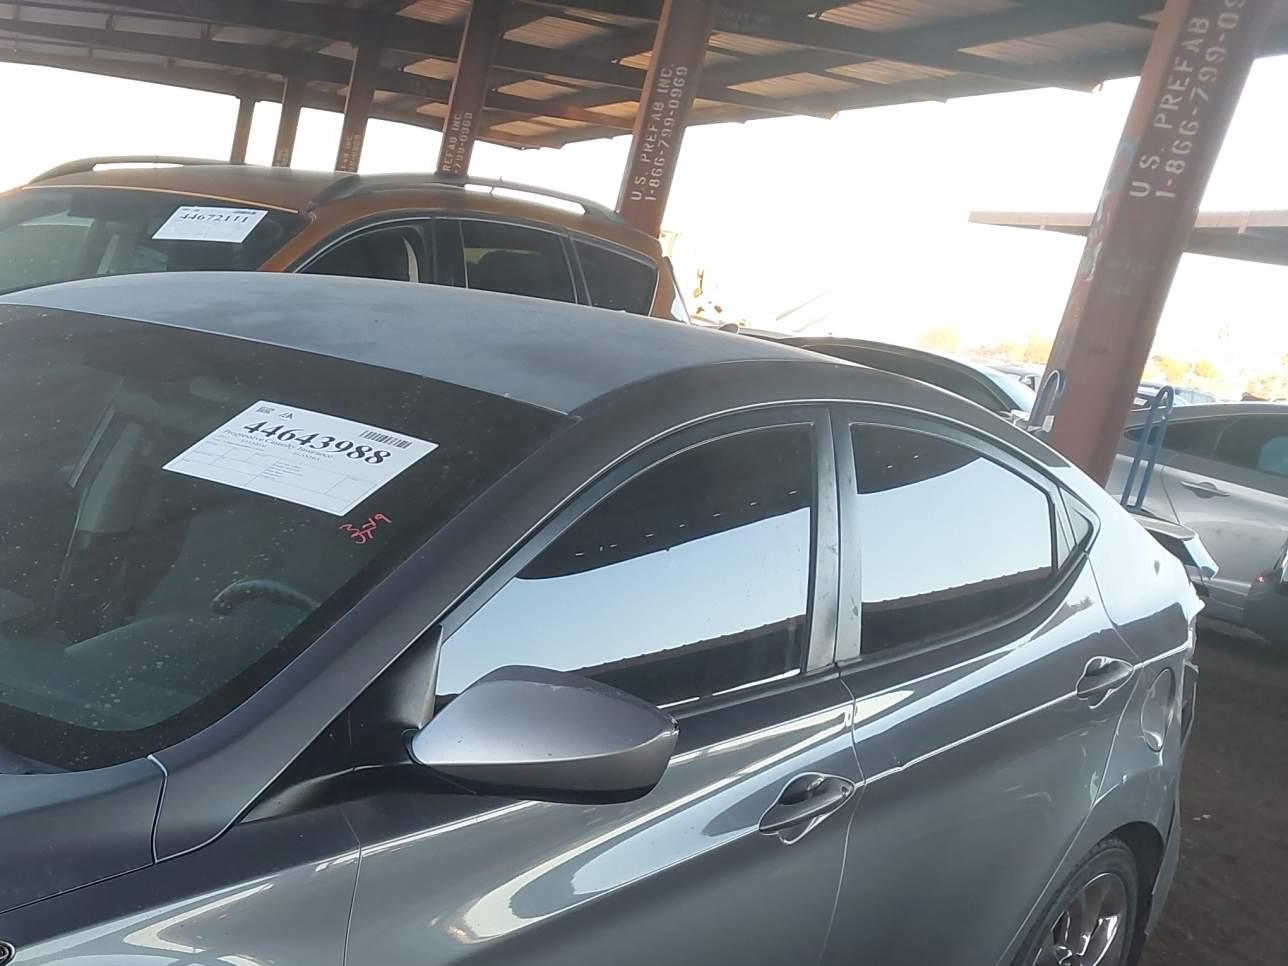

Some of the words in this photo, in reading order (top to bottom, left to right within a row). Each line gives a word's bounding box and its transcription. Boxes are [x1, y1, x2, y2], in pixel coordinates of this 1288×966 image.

[1153, 16, 1210, 129] PREFAB
[640, 101, 665, 162] PREFAB
[180, 213, 249, 223] 44672111
[243, 421, 391, 465] 44643988
